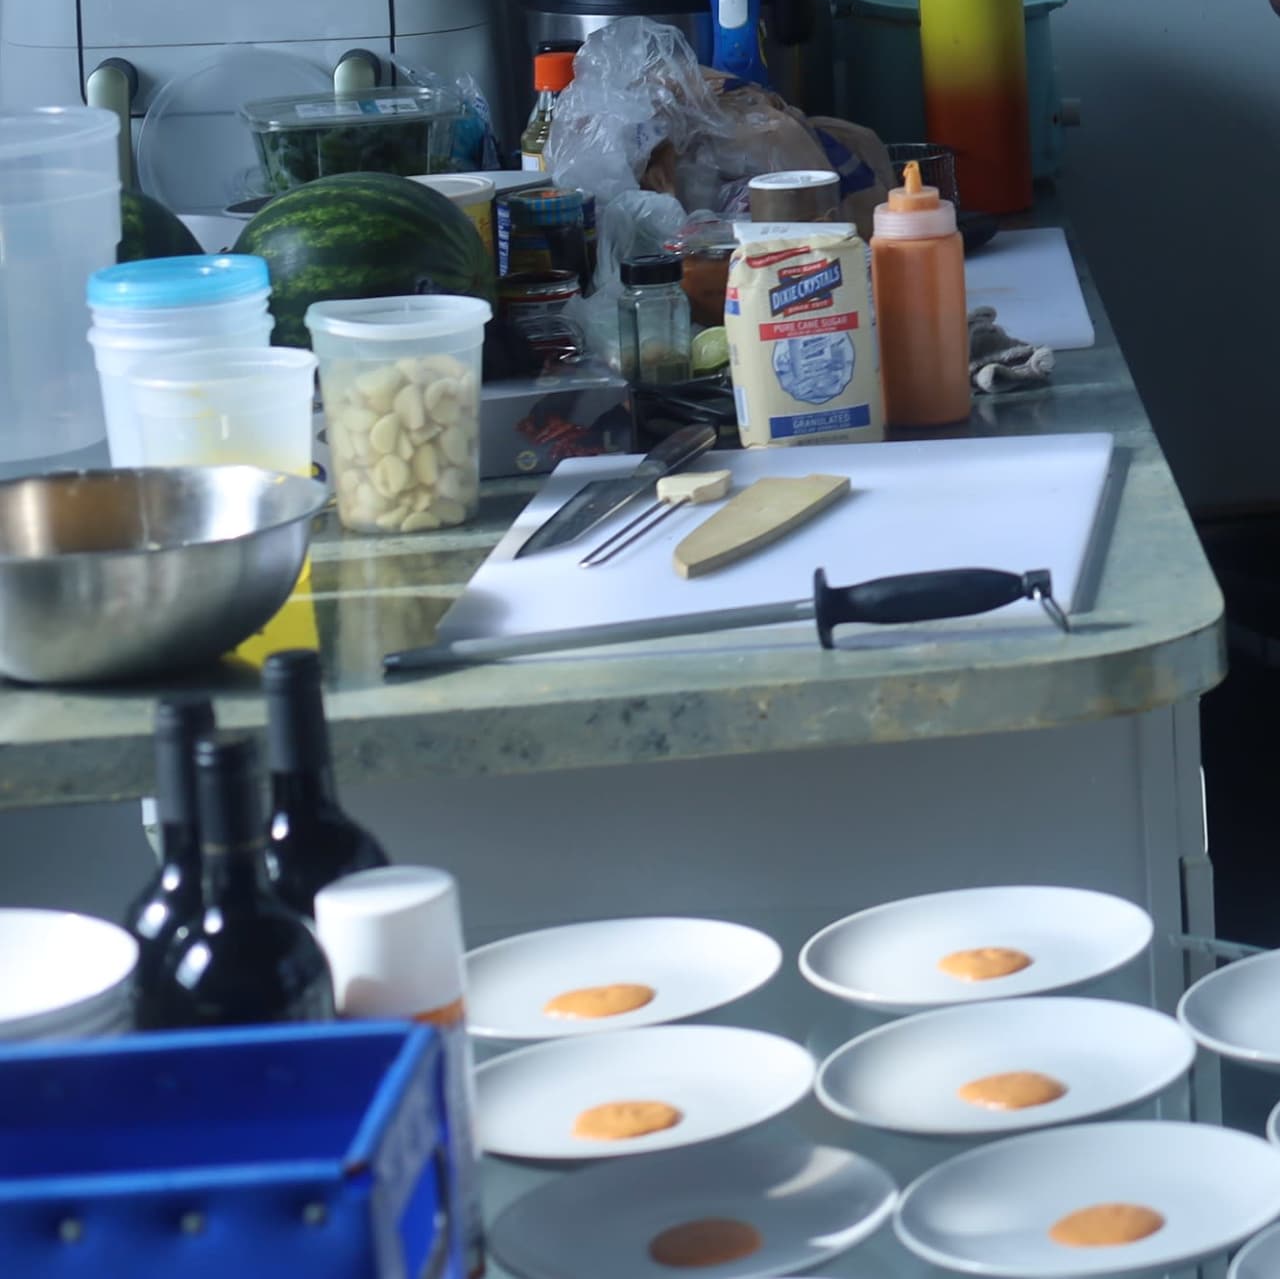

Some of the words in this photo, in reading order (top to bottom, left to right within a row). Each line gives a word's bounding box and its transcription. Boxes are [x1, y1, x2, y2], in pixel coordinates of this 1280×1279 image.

[771, 283, 798, 311] DIXIE
[797, 264, 840, 299] CRYSTALS
[773, 322, 795, 332] PURE
[796, 320, 818, 329] CANE
[821, 316, 848, 326] SUGAR
